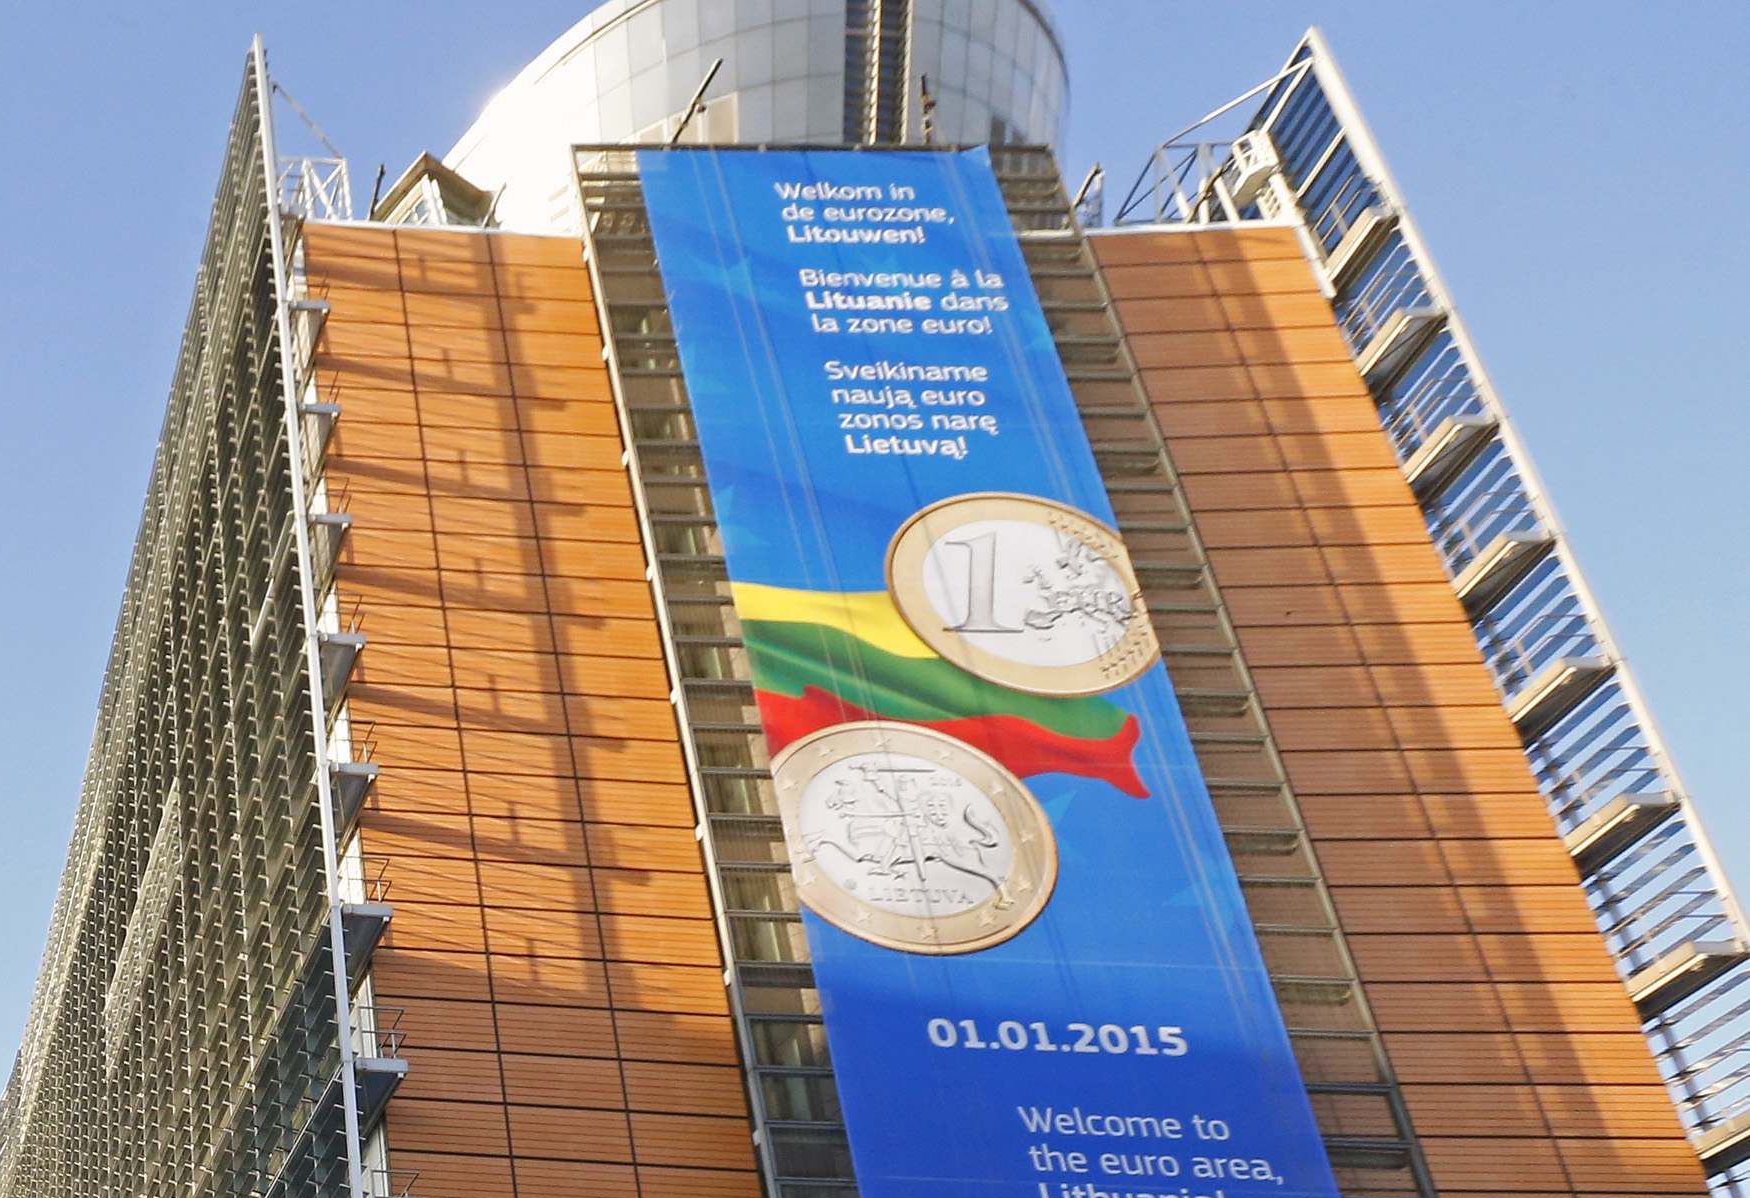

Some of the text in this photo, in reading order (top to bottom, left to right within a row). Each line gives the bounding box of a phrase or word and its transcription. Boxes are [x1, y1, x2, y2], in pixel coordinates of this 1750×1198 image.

[774, 182, 916, 200] Welkom in
[781, 203, 955, 224] de eurozone,
[786, 224, 927, 244] Litouwen!
[799, 268, 1004, 289] Bienvenue à la
[805, 291, 1010, 312] Lituanie dans
[811, 313, 994, 335] la zone euro!
[824, 360, 989, 382] Sveikiname
[831, 385, 986, 409] naują euro
[838, 411, 999, 436] zonos narę
[844, 433, 969, 460] Lietuvą!
[927, 1018, 1189, 1057] 01.01.2015
[1016, 1106, 1230, 1141] Welcome to
[1028, 1144, 1284, 1185] the euro area,
